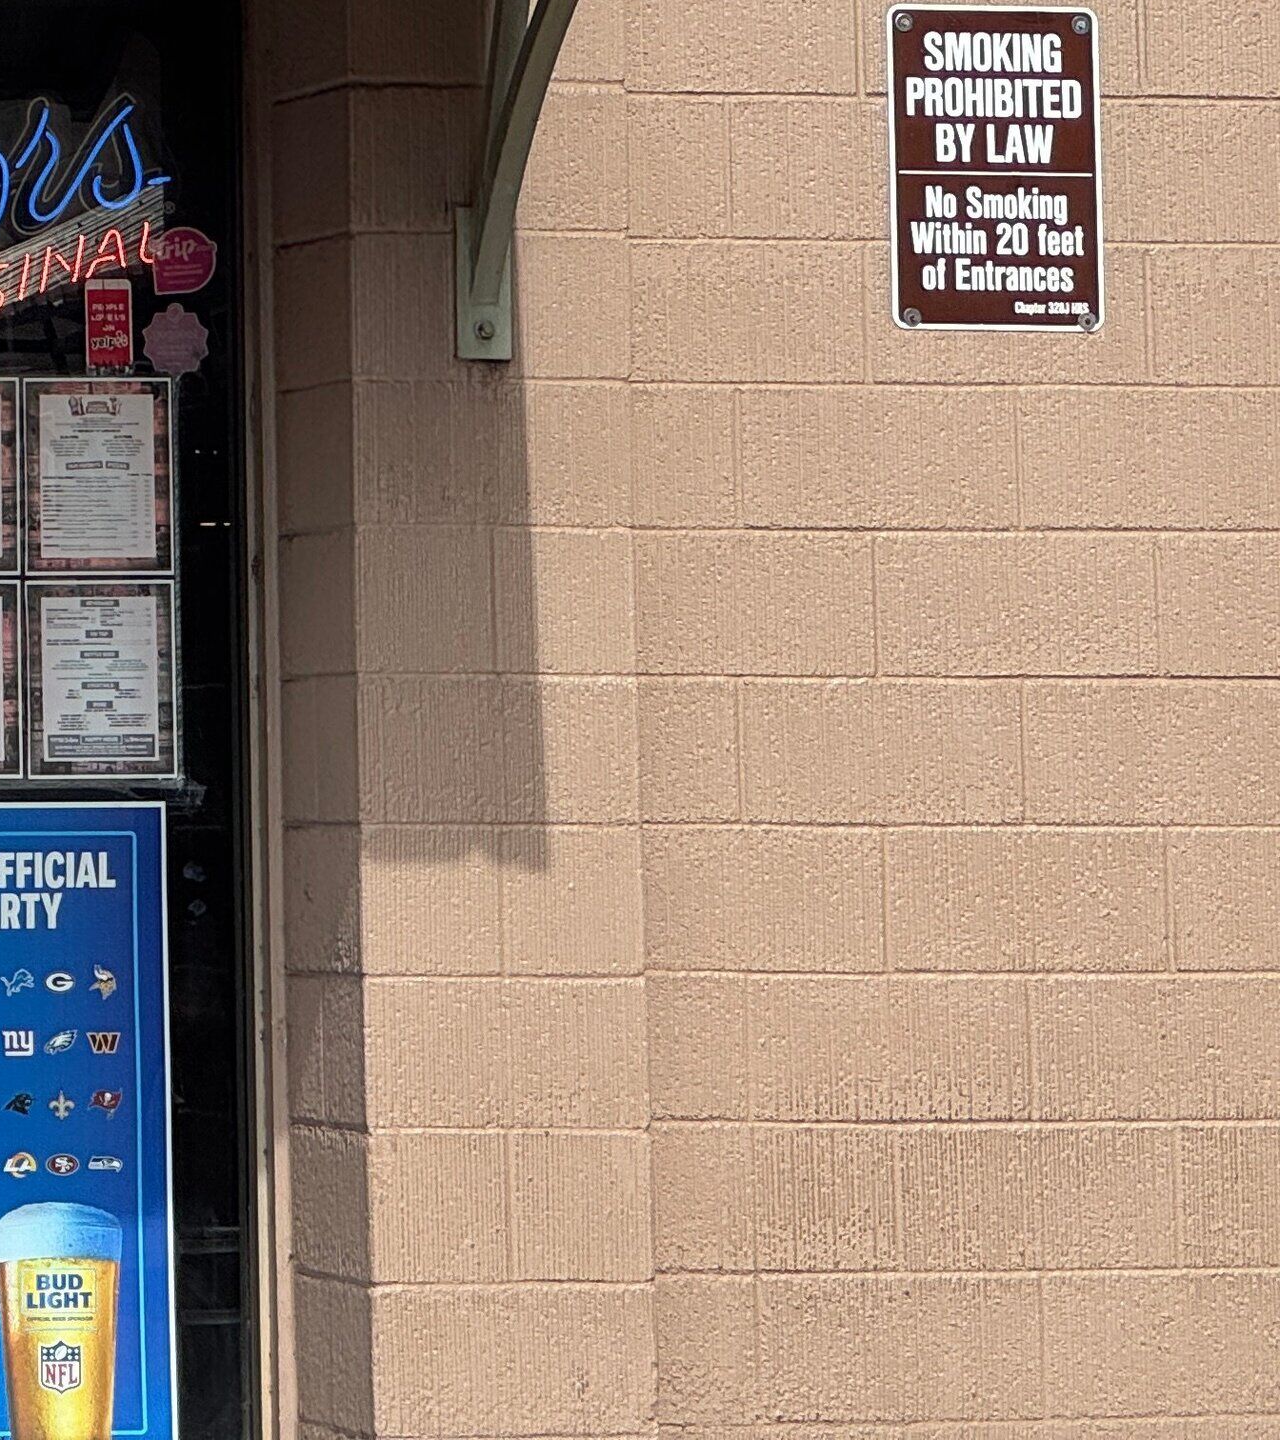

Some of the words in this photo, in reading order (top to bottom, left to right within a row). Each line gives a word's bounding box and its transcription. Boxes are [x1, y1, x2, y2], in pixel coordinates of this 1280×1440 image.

[923, 30, 1062, 74] SMOKING
[905, 76, 1083, 120] PROHIBITED
[935, 122, 976, 163] BY
[985, 123, 1054, 165] LAW
[924, 185, 958, 219] No
[965, 185, 1069, 227] Smoking
[909, 221, 988, 256] Within
[995, 222, 1029, 256] 20
[1037, 223, 1085, 257] feet
[921, 257, 947, 291] of
[954, 258, 1075, 293] Entrances
[90, 334, 118, 351] yelp
[26, 1291, 93, 1309] LIGHT
[36, 1273, 84, 1291] BUD
[45, 1363, 78, 1388] NFL
